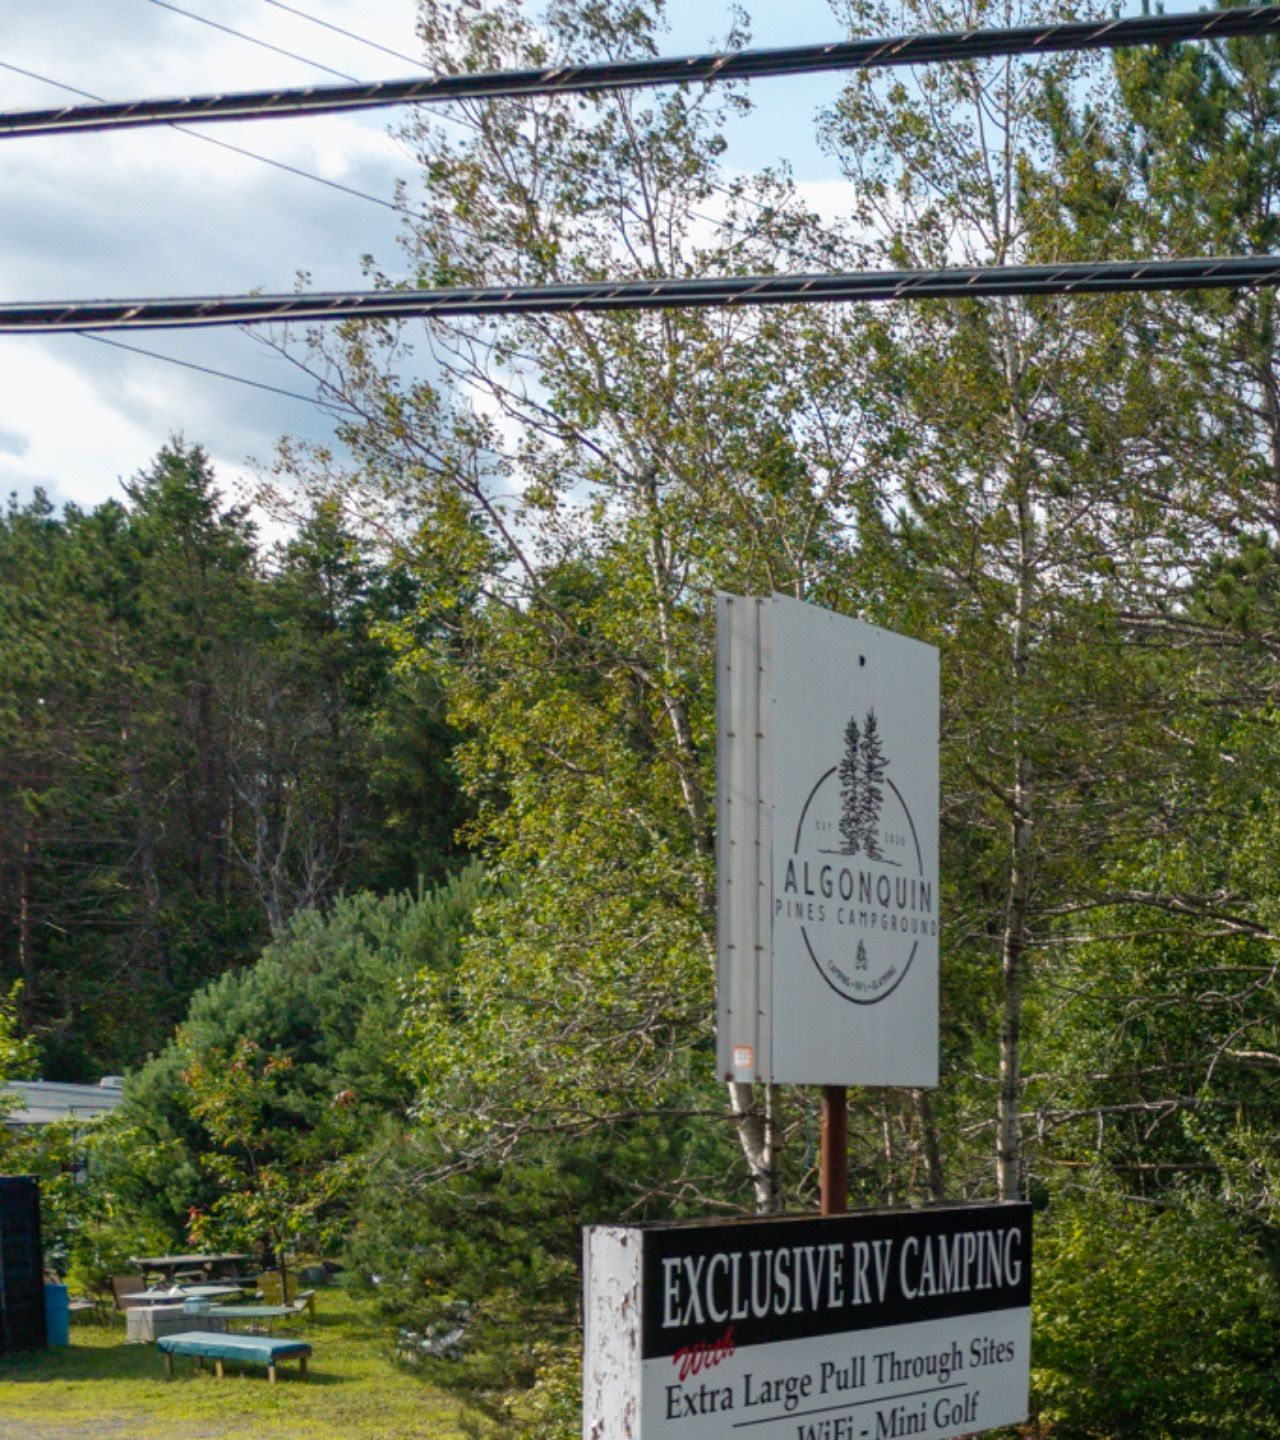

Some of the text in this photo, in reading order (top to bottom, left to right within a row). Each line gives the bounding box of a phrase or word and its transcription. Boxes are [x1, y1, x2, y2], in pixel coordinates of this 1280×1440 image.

[784, 859, 932, 914] ALGONQUIN
[775, 899, 937, 937] PINES CAMPGROUND
[662, 1227, 1022, 1328] EXCLUSIVE RV CAMPING
[665, 1337, 1015, 1420] Extra Large Pull Through Sites
[672, 1326, 736, 1382] With
[934, 1391, 980, 1429] Golf
